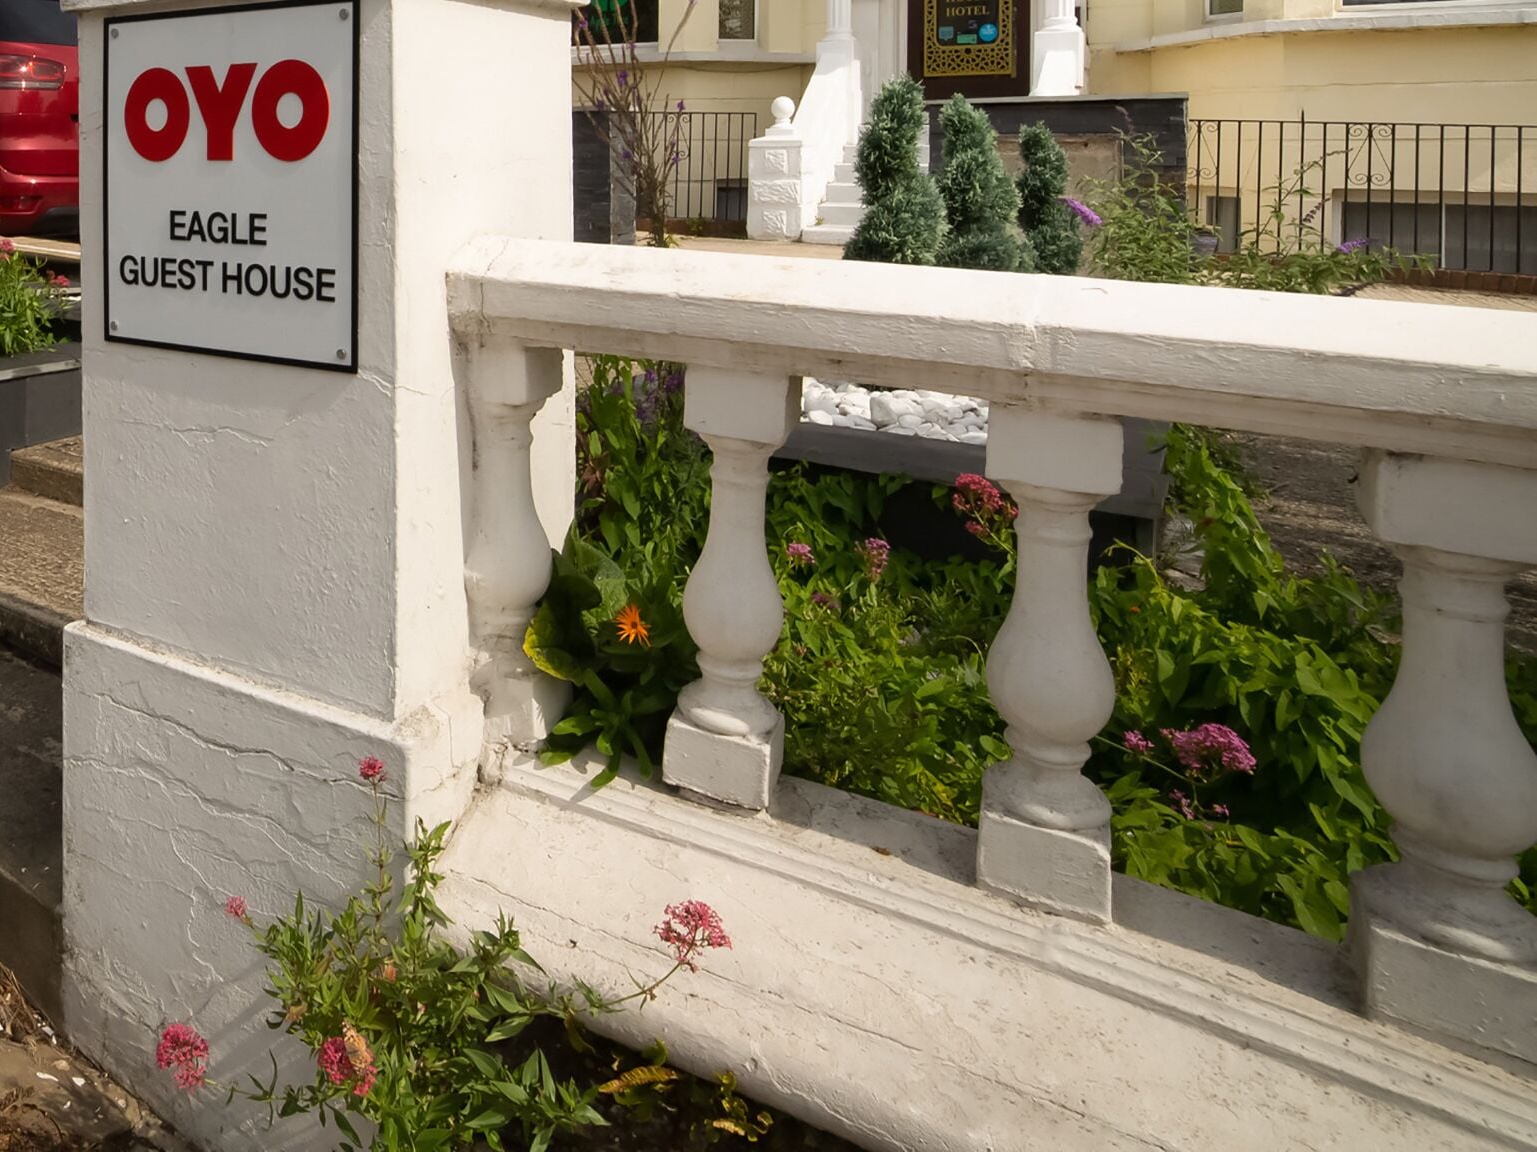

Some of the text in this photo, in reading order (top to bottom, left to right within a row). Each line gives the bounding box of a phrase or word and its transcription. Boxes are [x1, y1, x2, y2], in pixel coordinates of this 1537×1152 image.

[946, 5, 990, 17] HOTEL
[124, 59, 330, 162] OYO
[170, 209, 267, 246] EAGLE
[119, 255, 336, 303] GUEST HOUSE
